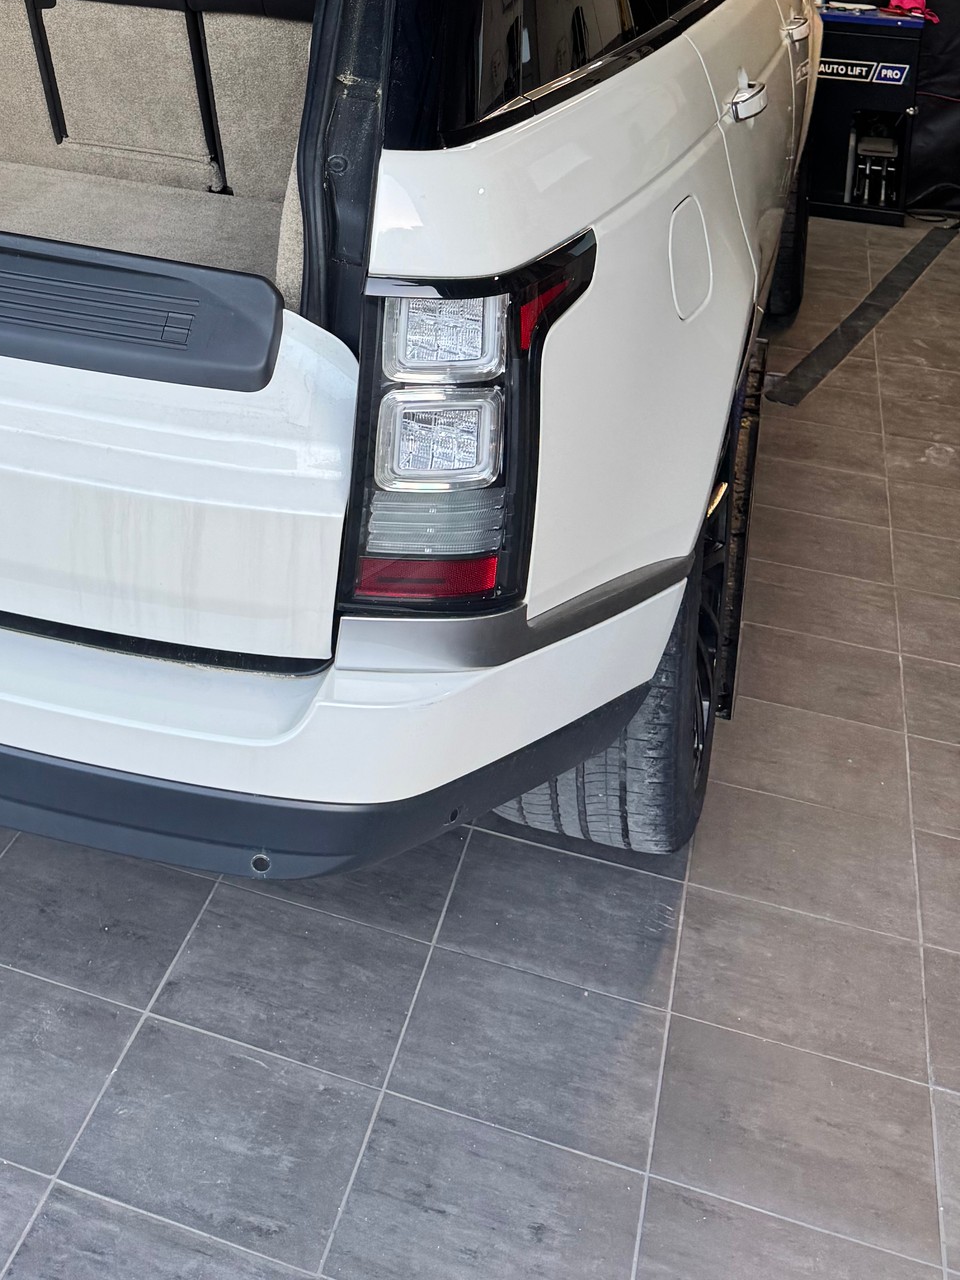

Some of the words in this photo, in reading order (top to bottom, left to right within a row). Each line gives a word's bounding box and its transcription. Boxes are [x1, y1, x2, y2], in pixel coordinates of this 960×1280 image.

[818, 63, 846, 74] AUTO
[847, 66, 868, 77] LIFT
[881, 69, 901, 79] PRO
